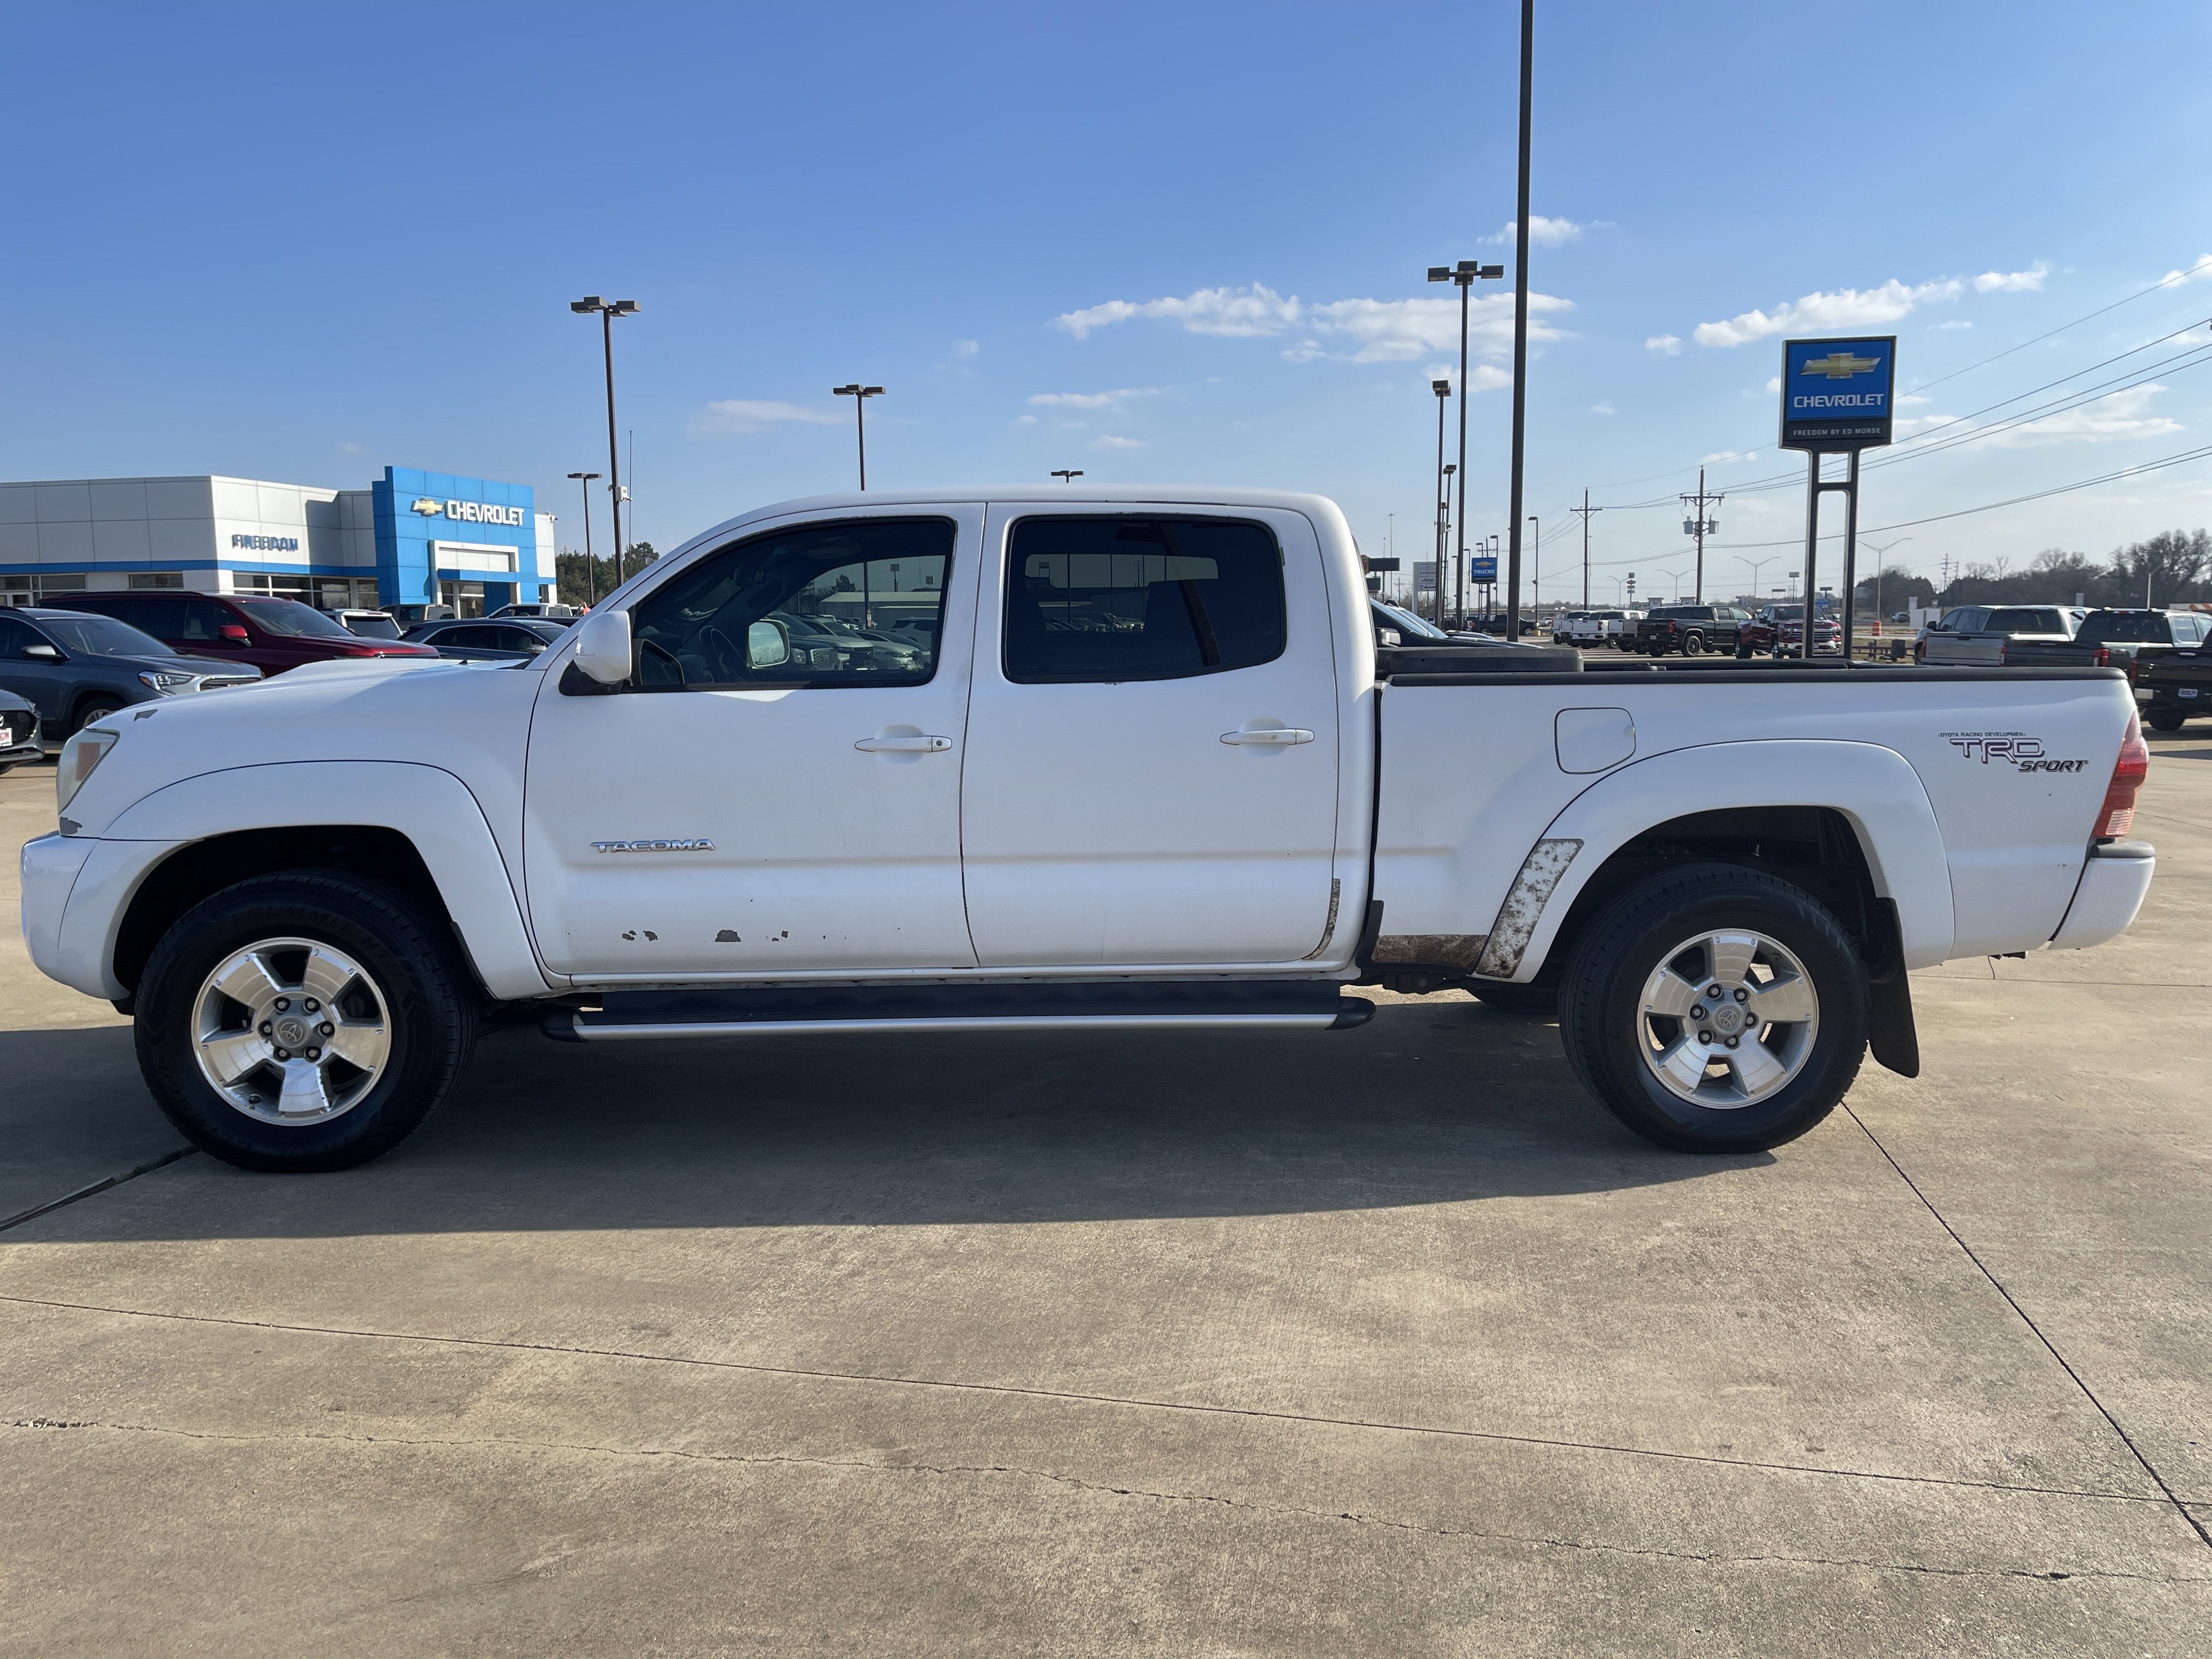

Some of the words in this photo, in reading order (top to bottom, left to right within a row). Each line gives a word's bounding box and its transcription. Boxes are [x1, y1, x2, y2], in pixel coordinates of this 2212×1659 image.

[1793, 394, 1884, 408] CHEVROLET
[445, 500, 525, 526] CHEVROLET
[232, 534, 298, 551] FREEDOM
[1950, 738, 2045, 764] TRD
[2018, 760, 2089, 773] SPORT
[590, 839, 715, 853] TACOMA
